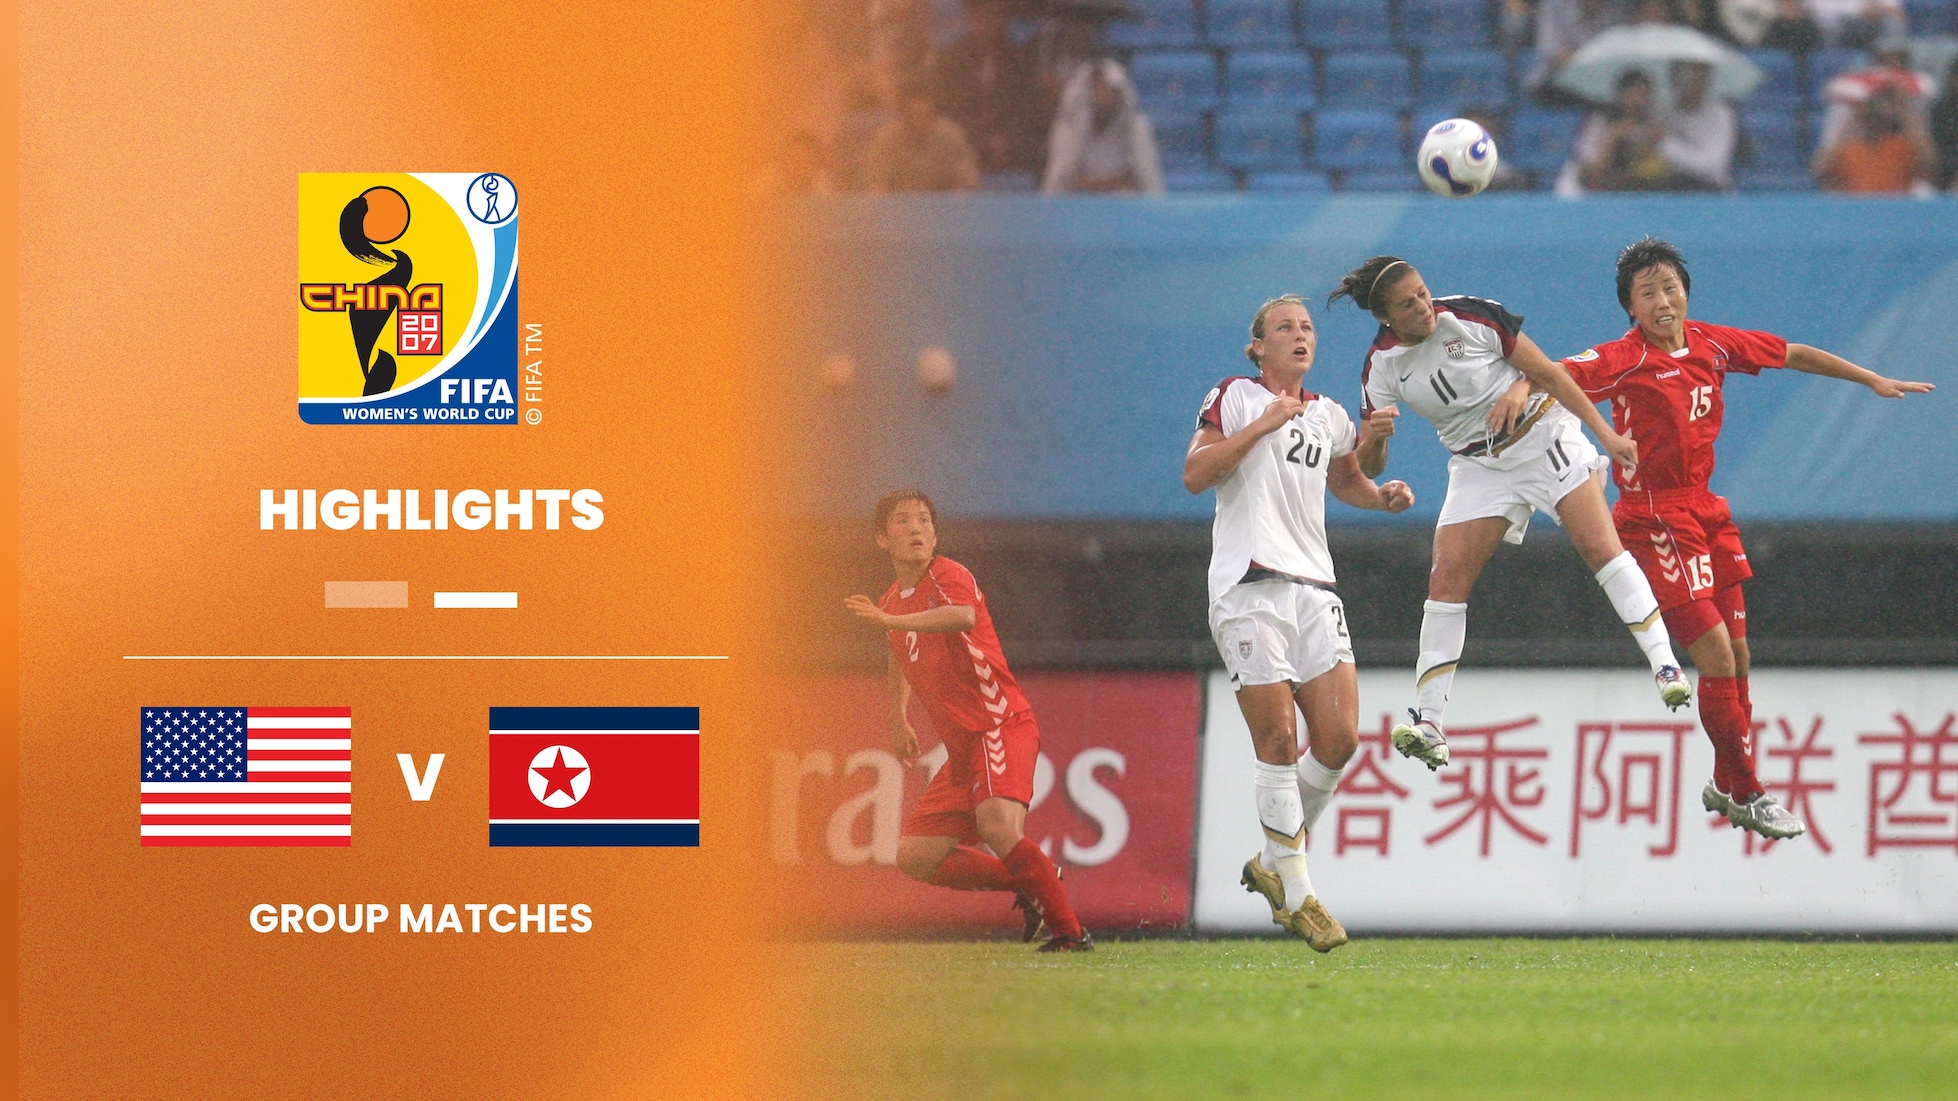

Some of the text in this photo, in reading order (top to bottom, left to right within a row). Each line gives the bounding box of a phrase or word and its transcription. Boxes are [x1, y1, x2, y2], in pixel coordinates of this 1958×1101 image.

[1430, 367, 1459, 406] 11
[1689, 385, 1713, 422] 15
[1286, 428, 1322, 468] 20
[1545, 438, 1571, 473] 11
[1687, 553, 1715, 591] 15
[905, 630, 920, 663] 2
